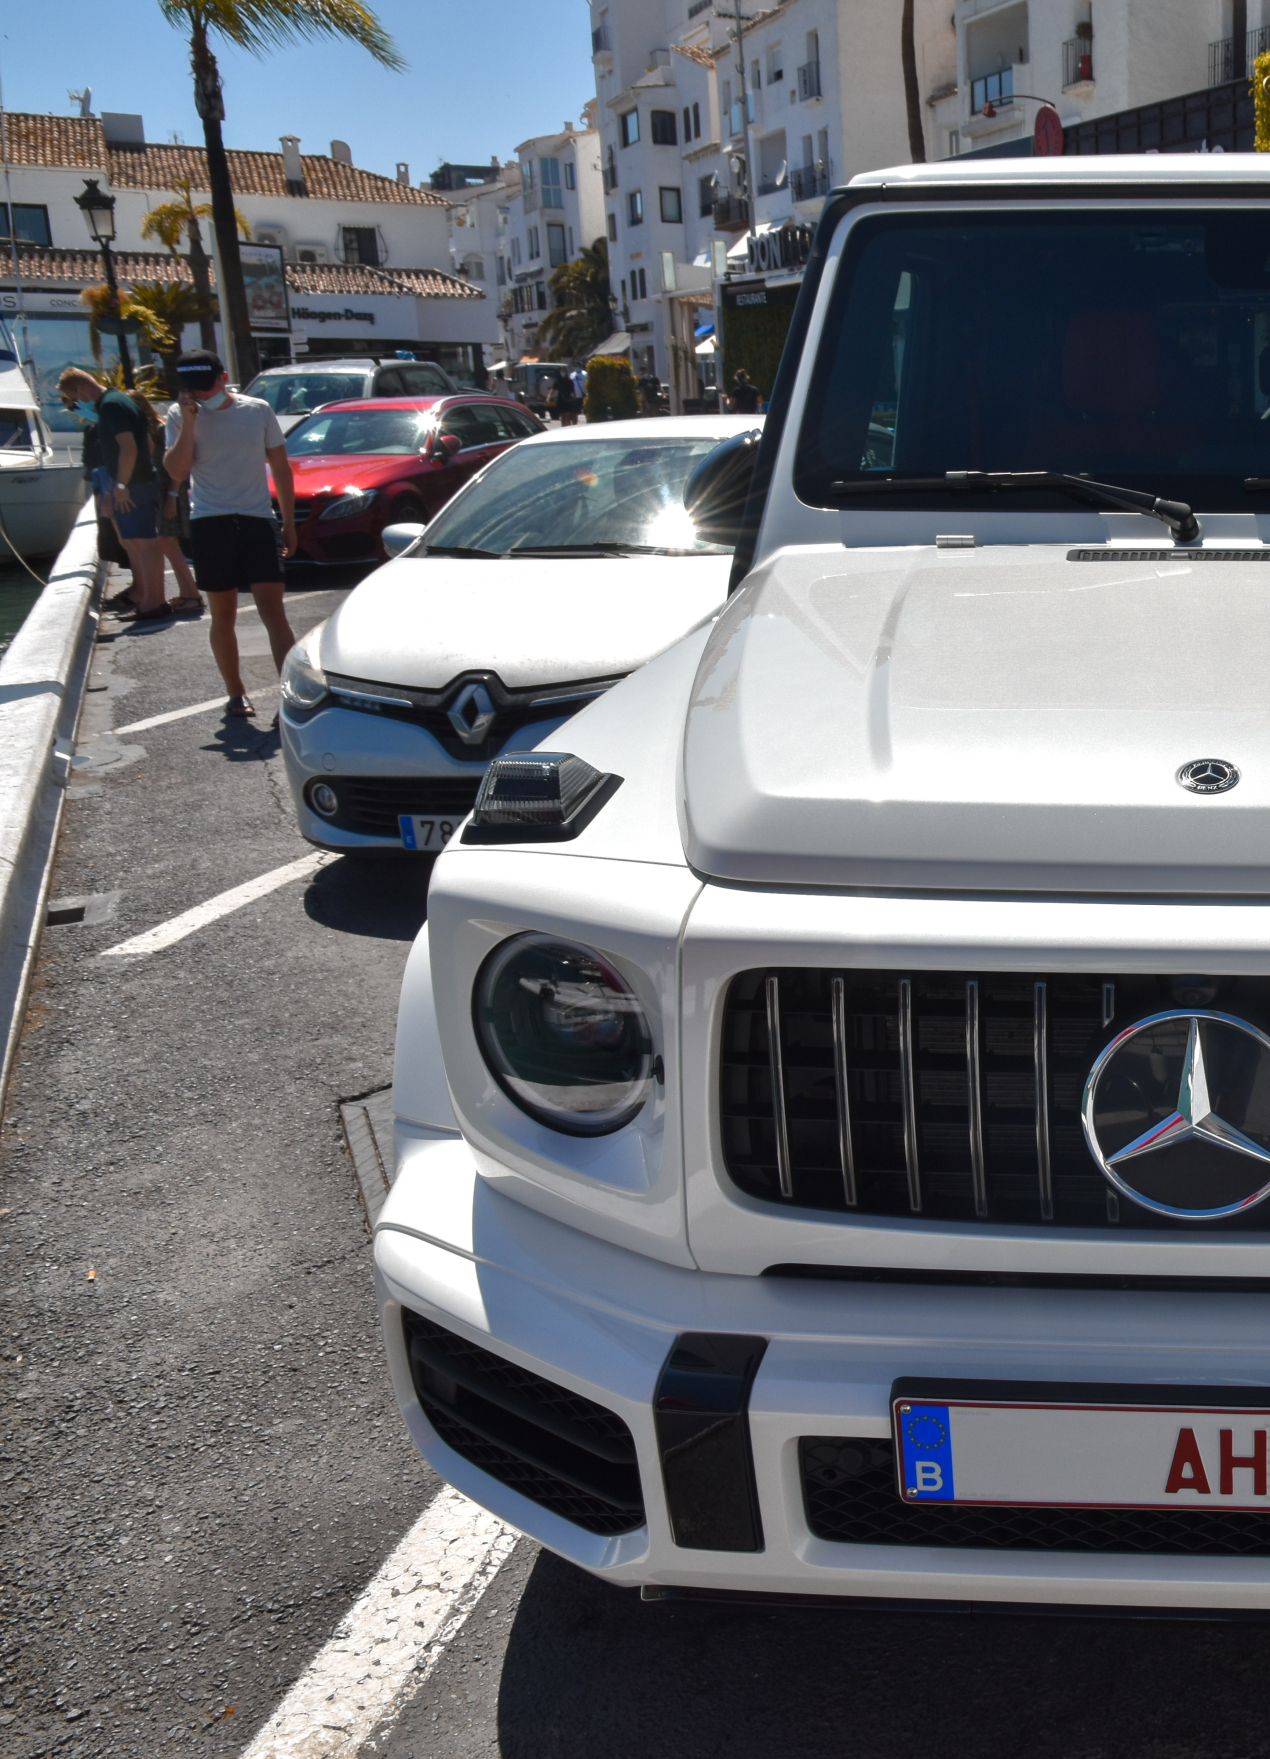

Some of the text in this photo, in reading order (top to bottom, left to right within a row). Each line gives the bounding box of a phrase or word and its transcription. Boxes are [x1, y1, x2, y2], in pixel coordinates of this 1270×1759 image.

[0, 294, 17, 308] S
[49, 298, 80, 308] CONC
[291, 307, 375, 326] Häagen-Dazs
[420, 820, 462, 847] 78
[1165, 1427, 1268, 1496] AH
[916, 1460, 944, 1492] B
